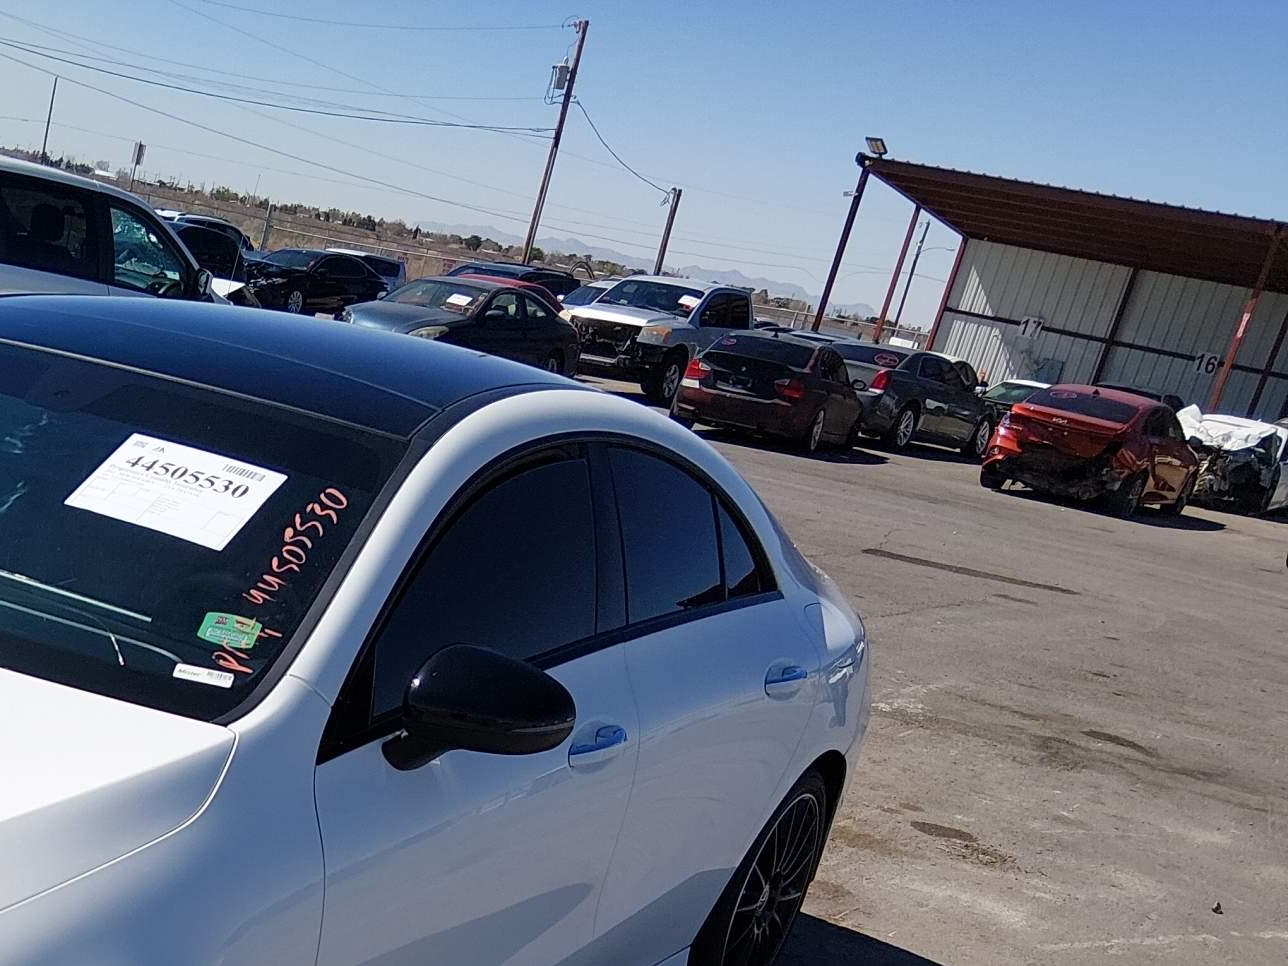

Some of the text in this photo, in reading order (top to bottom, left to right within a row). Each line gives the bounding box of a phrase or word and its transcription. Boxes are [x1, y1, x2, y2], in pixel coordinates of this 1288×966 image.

[1020, 318, 1043, 337] 17
[1195, 353, 1218, 374] 16
[125, 455, 250, 499] 44505530
[242, 487, 348, 604] 44505530
